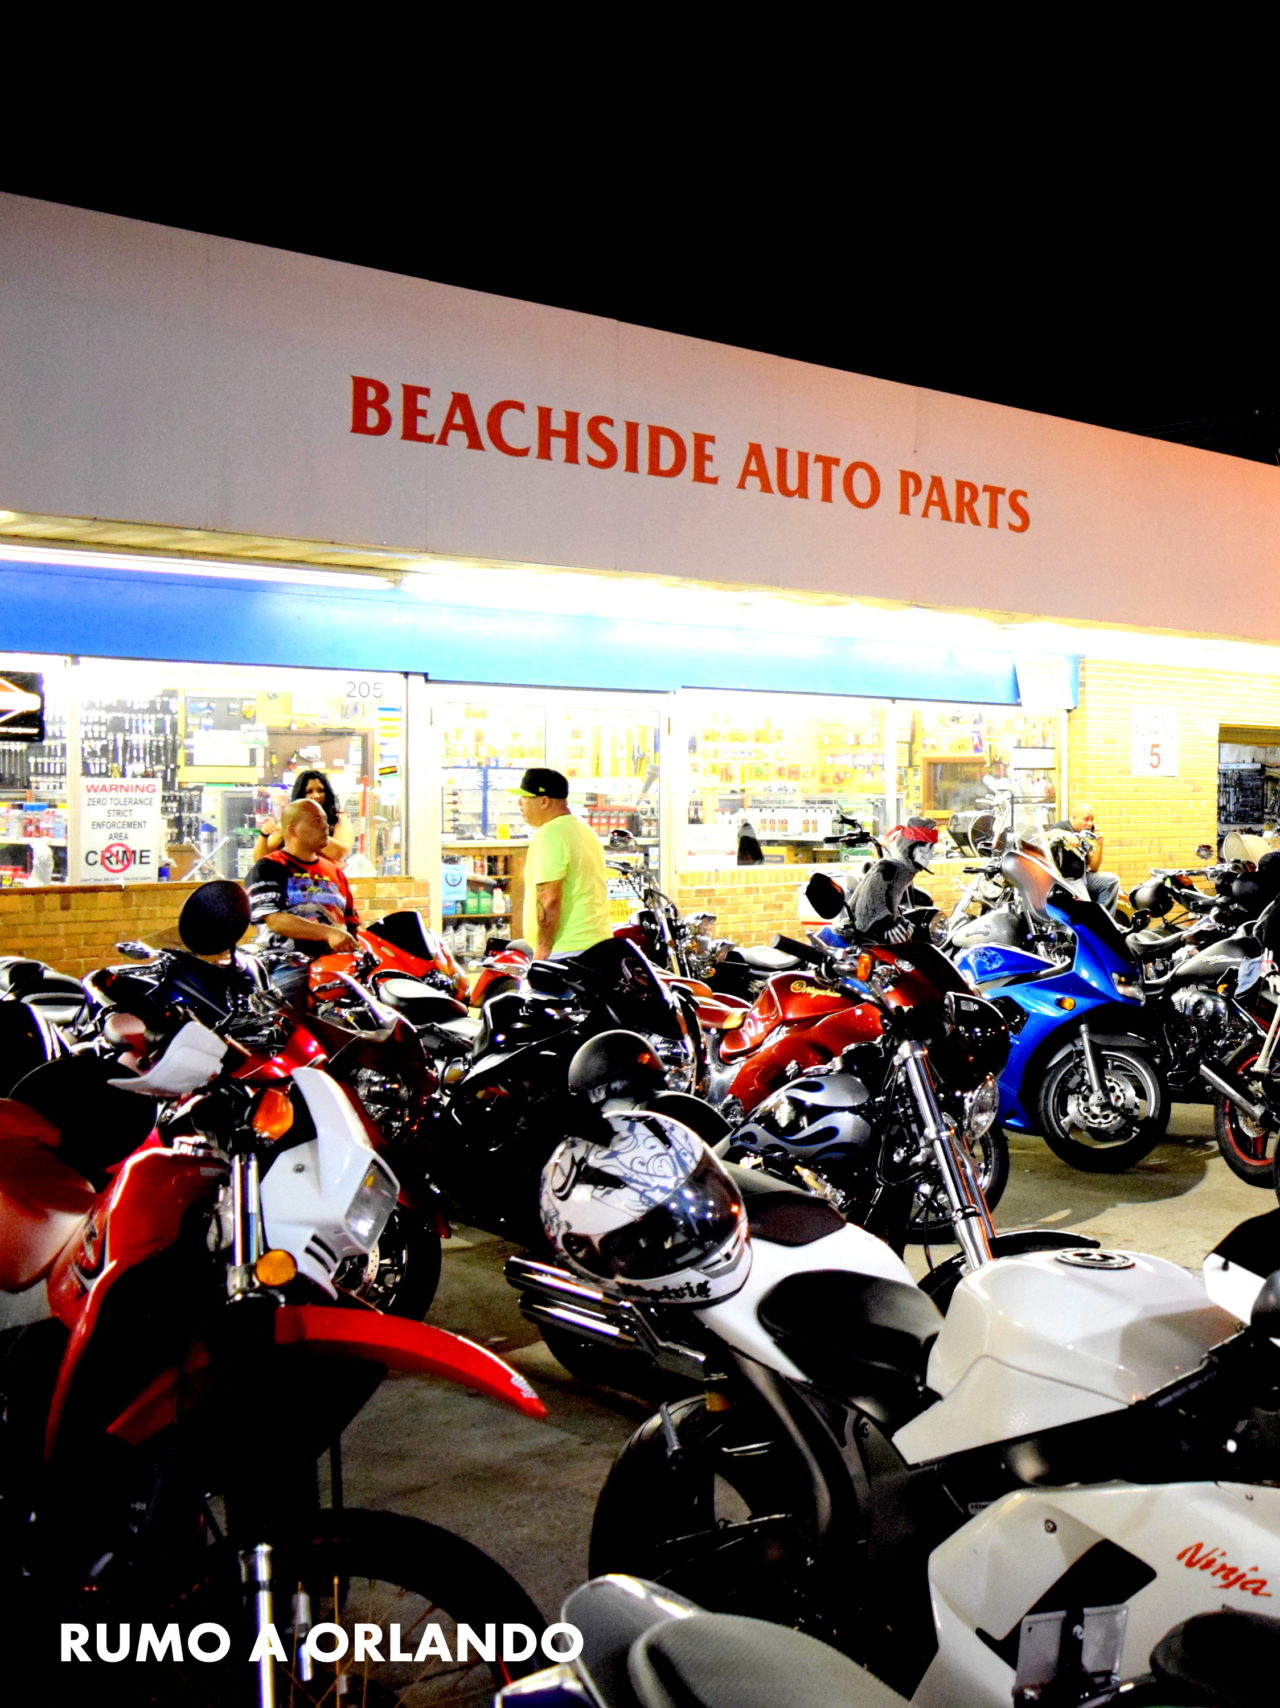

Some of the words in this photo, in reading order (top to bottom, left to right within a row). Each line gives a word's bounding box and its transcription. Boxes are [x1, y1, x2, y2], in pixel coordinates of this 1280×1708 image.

[349, 374, 720, 485] BEACHSIDE
[736, 441, 881, 510] AUTO
[898, 469, 1031, 534] PARTS
[346, 681, 384, 699] 205
[1149, 743, 1161, 769] 5
[85, 784, 157, 794] WARNING
[87, 797, 108, 807] ZERO
[109, 797, 154, 807] TOLERANCE
[106, 809, 133, 818] STRICT
[91, 820, 148, 830] ENFORCEMENT
[108, 832, 129, 841] AREA
[1176, 1541, 1273, 1598] Ninja
